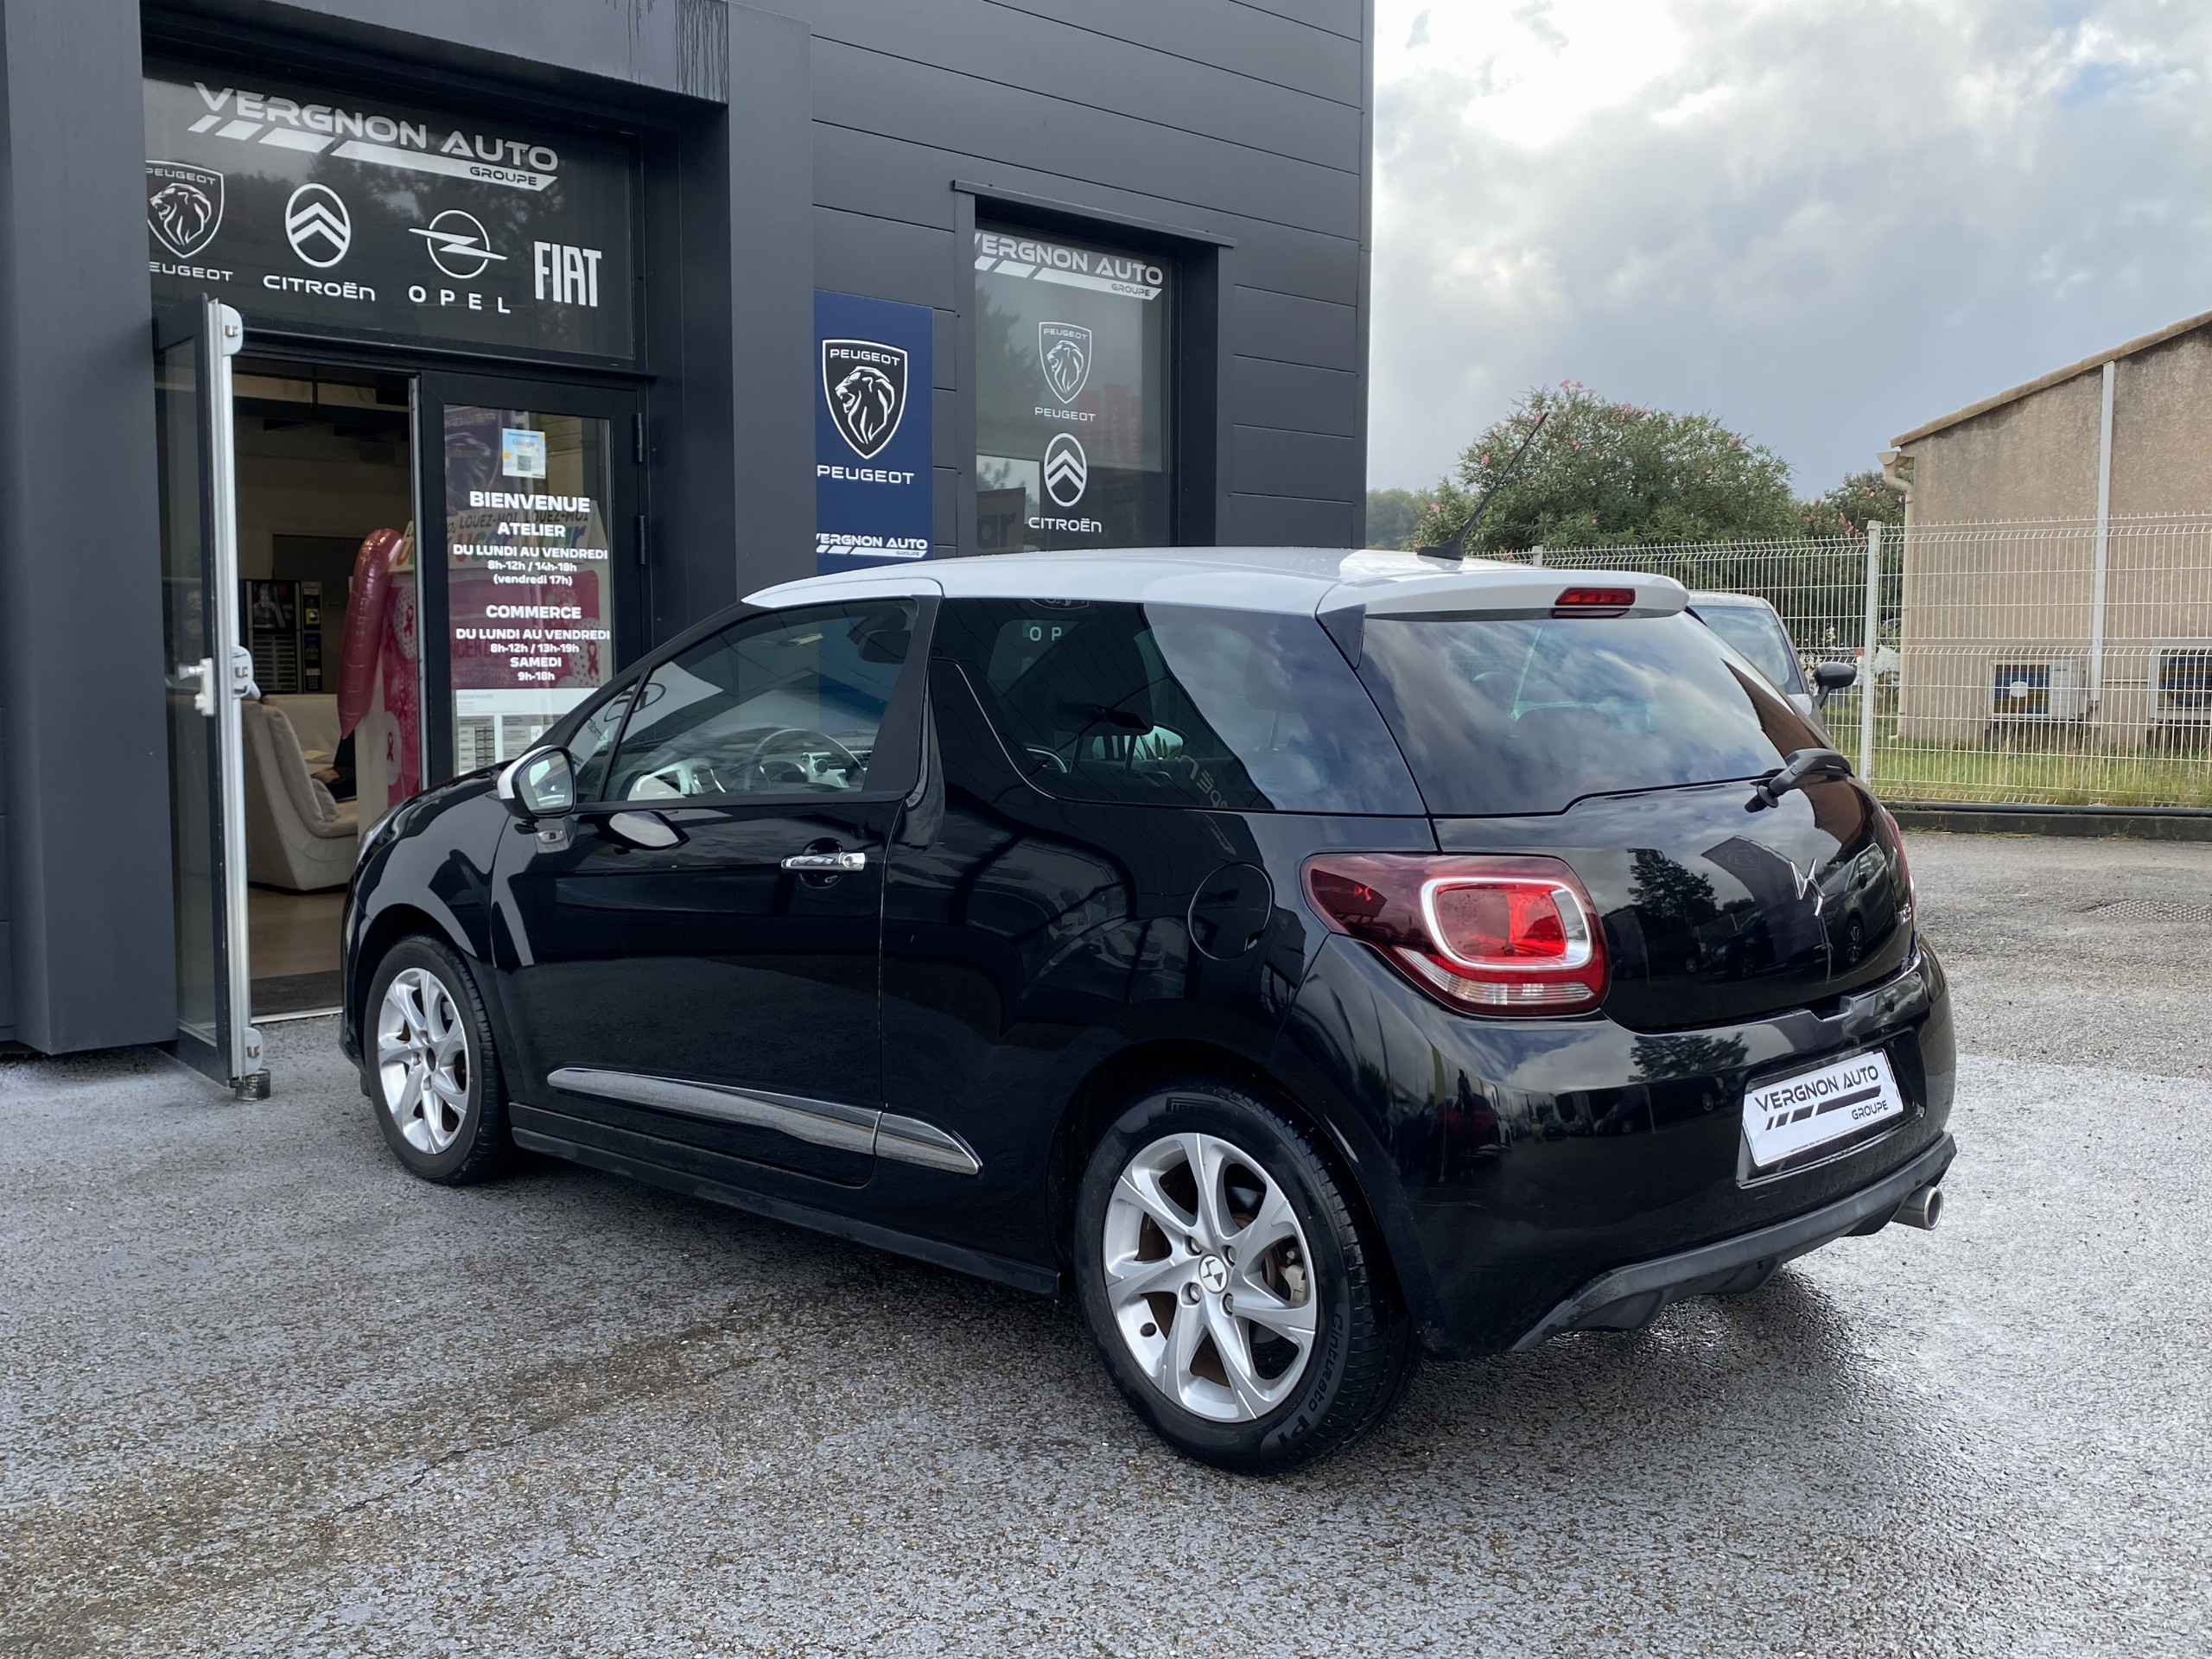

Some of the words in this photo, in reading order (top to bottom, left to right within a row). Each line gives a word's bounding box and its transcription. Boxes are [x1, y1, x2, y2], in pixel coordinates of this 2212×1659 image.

[194, 81, 428, 149] VERGNON
[440, 130, 558, 172] AUTO
[468, 165, 537, 187] GROUPE
[149, 261, 233, 282] EUGEOT
[533, 240, 602, 307] FIAT
[1094, 257, 1163, 285] AUTO
[1110, 282, 1151, 297] GROUPE
[1043, 327, 1088, 341] PEUGEOT
[830, 348, 900, 366] PEUGEOT
[1034, 406, 1096, 423] PEUGEOT
[817, 464, 915, 485] PEUGEOT
[469, 491, 591, 512] BIENVENUE
[497, 522, 566, 537] ATELIER
[453, 543, 474, 556] DU
[476, 544, 518, 557] LUNDI
[520, 546, 539, 558] AU
[542, 548, 608, 560] VENDREDI
[886, 537, 928, 550] AUTO
[487, 560, 525, 571] 8h-12h
[535, 562, 577, 572] 14h-18h
[493, 574, 548, 586] (vendredi
[549, 575, 573, 587] 17h)
[486, 605, 582, 620] COMMERCE
[455, 628, 476, 639] DU
[479, 628, 519, 639] LUNDI
[523, 629, 543, 639] AU
[544, 629, 611, 640] VENDREDI
[490, 643, 529, 653] 8h-12h
[537, 643, 580, 653] 13h-19h
[510, 657, 562, 668] SAMEDI
[517, 671, 556, 682] 9h-18h
[1754, 1077, 1840, 1112] VERGNON
[1843, 1065, 1879, 1090] AUTO
[1851, 1099, 1889, 1121] GROUPE
